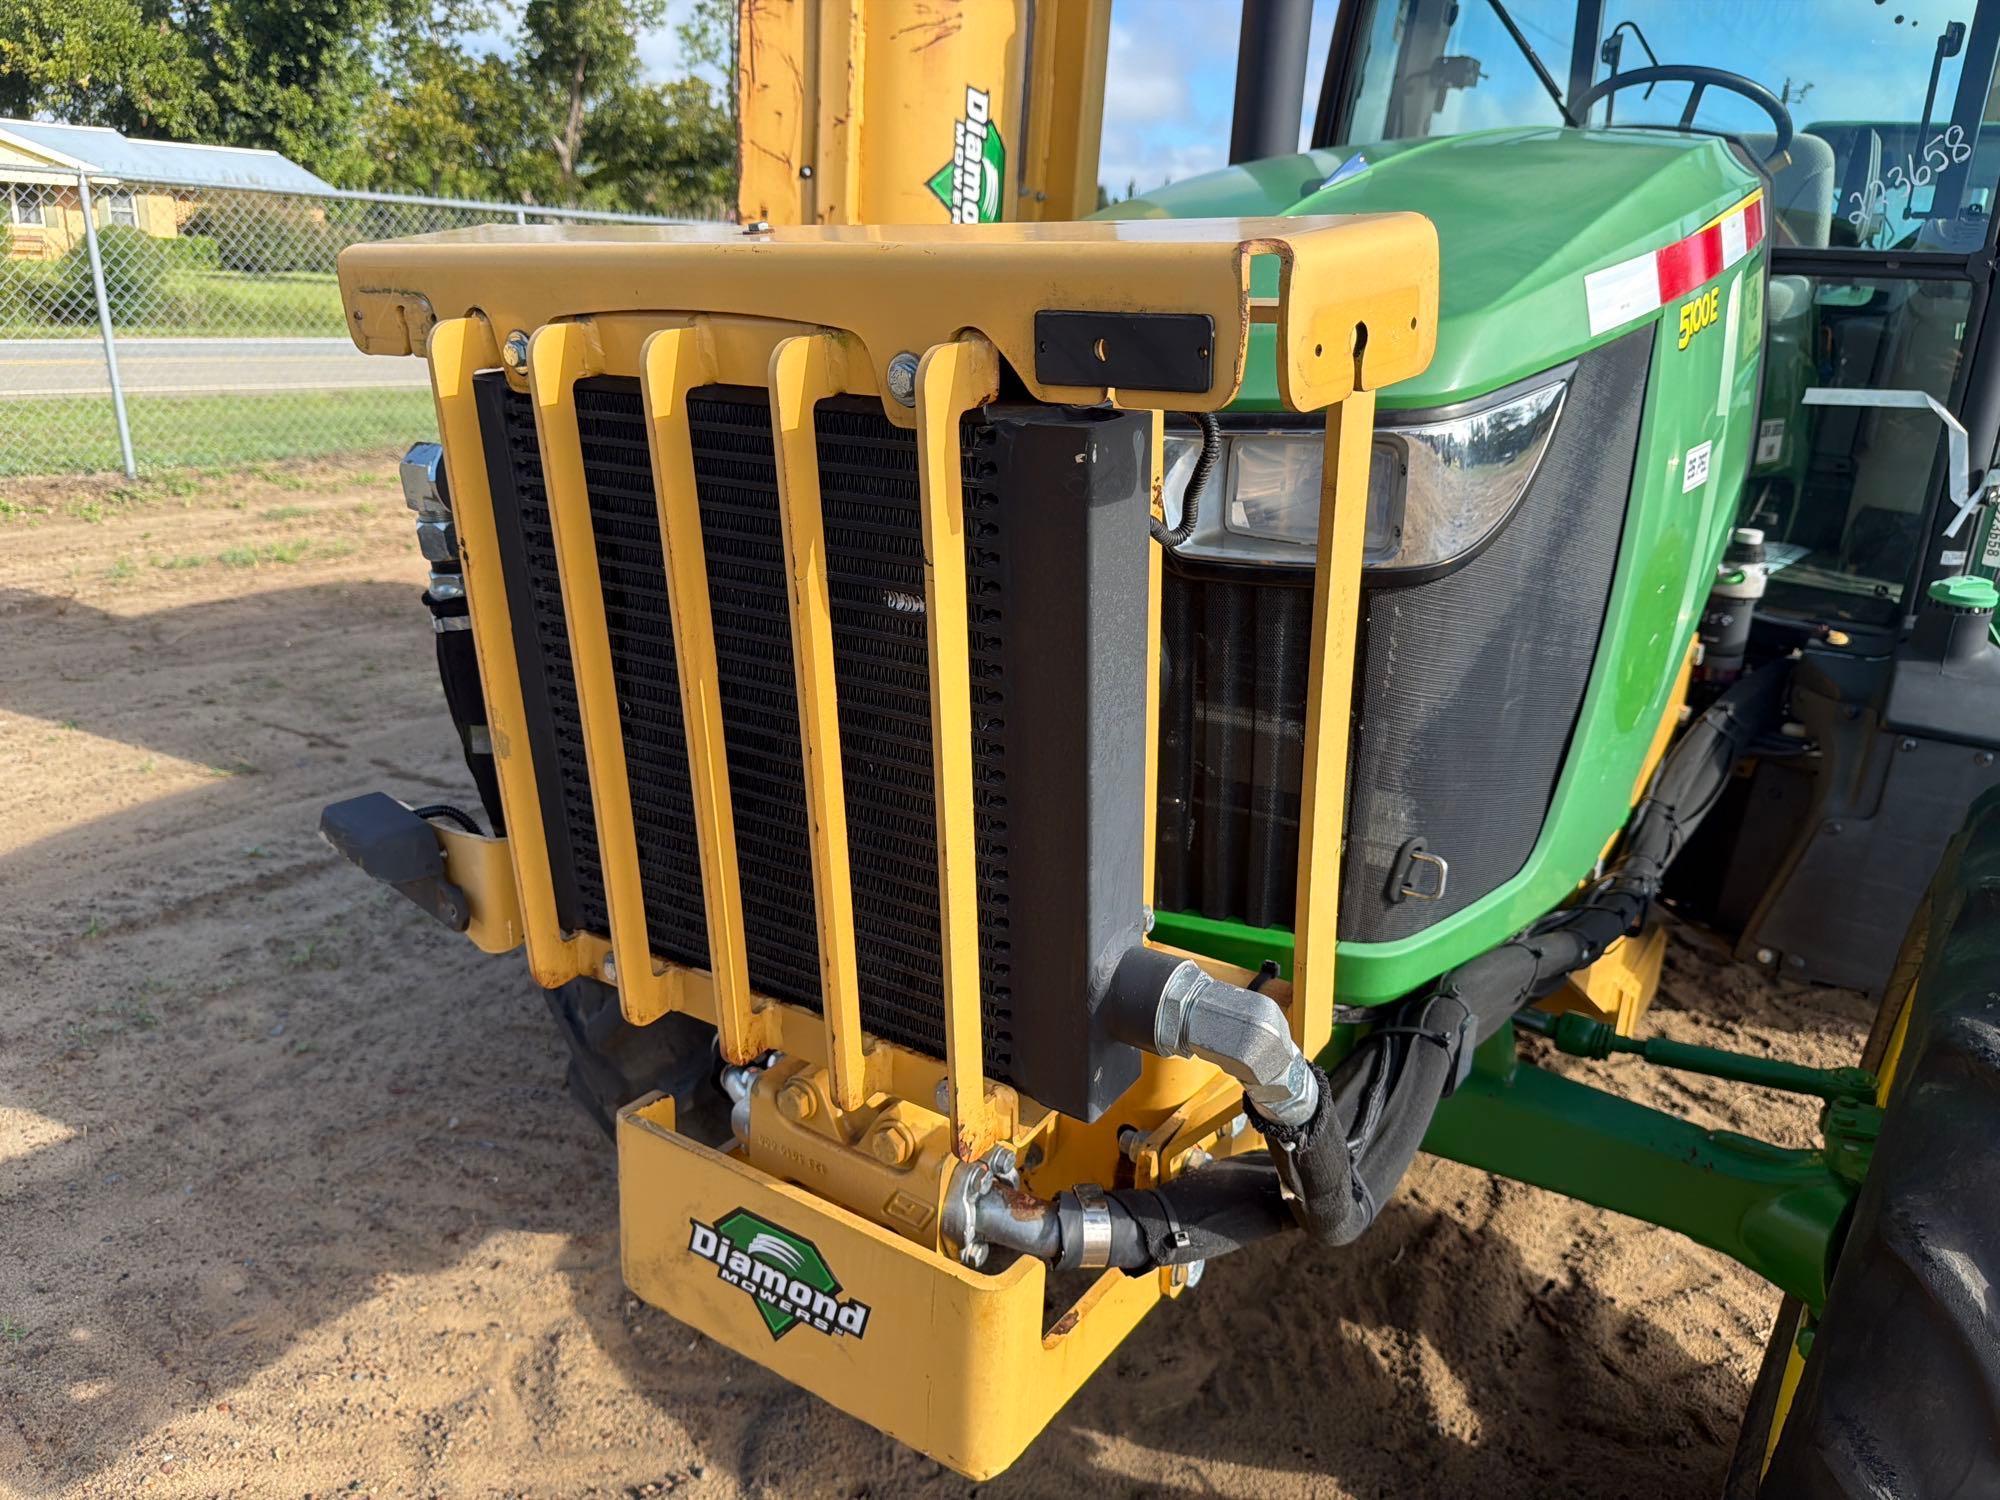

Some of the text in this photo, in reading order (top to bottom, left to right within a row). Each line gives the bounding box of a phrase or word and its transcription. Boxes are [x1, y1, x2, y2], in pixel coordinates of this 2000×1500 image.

[1848, 125, 1971, 224] 223658
[1678, 286, 1720, 350] 5100E
[690, 1222, 868, 1335] Diamond
[719, 1269, 829, 1331] MOWERS
